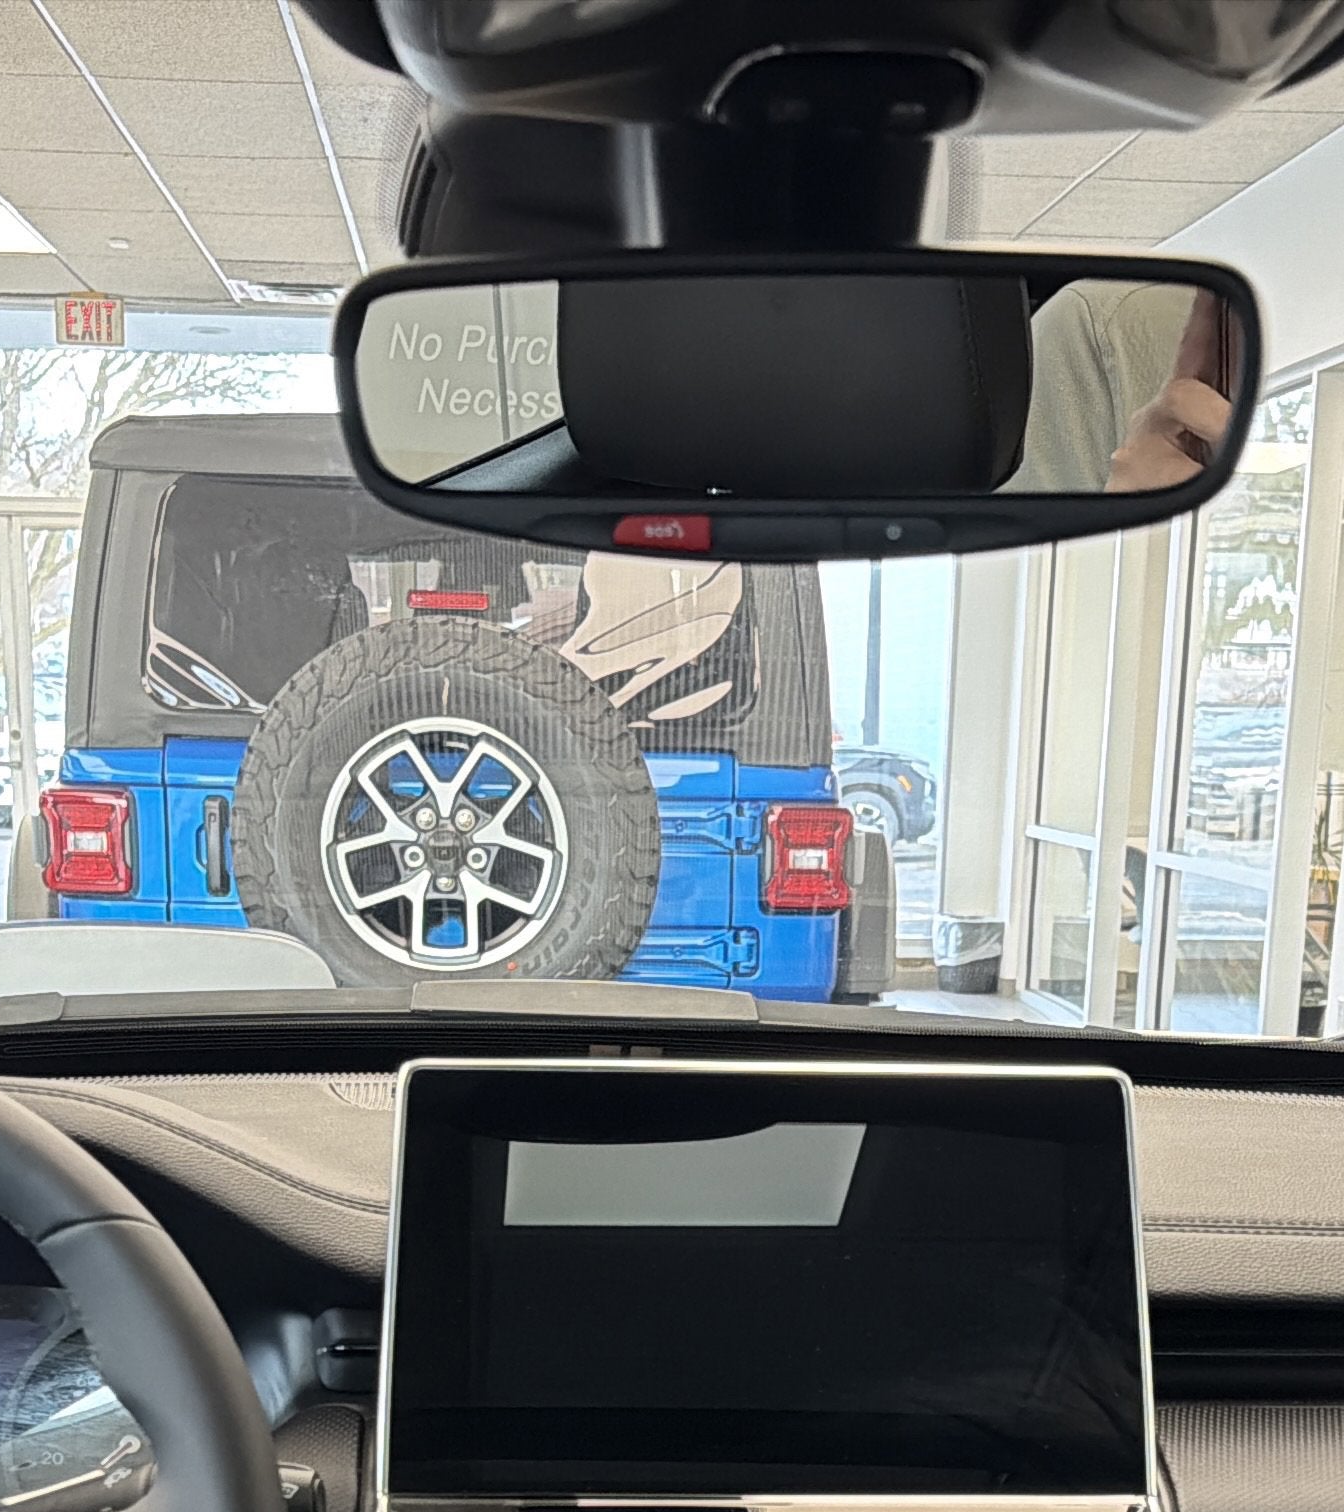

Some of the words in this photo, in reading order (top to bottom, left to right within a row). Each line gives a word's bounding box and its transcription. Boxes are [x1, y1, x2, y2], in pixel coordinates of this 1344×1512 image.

[65, 301, 116, 341] EXIT
[389, 322, 442, 361] No
[42, 1451, 64, 1465] 20
